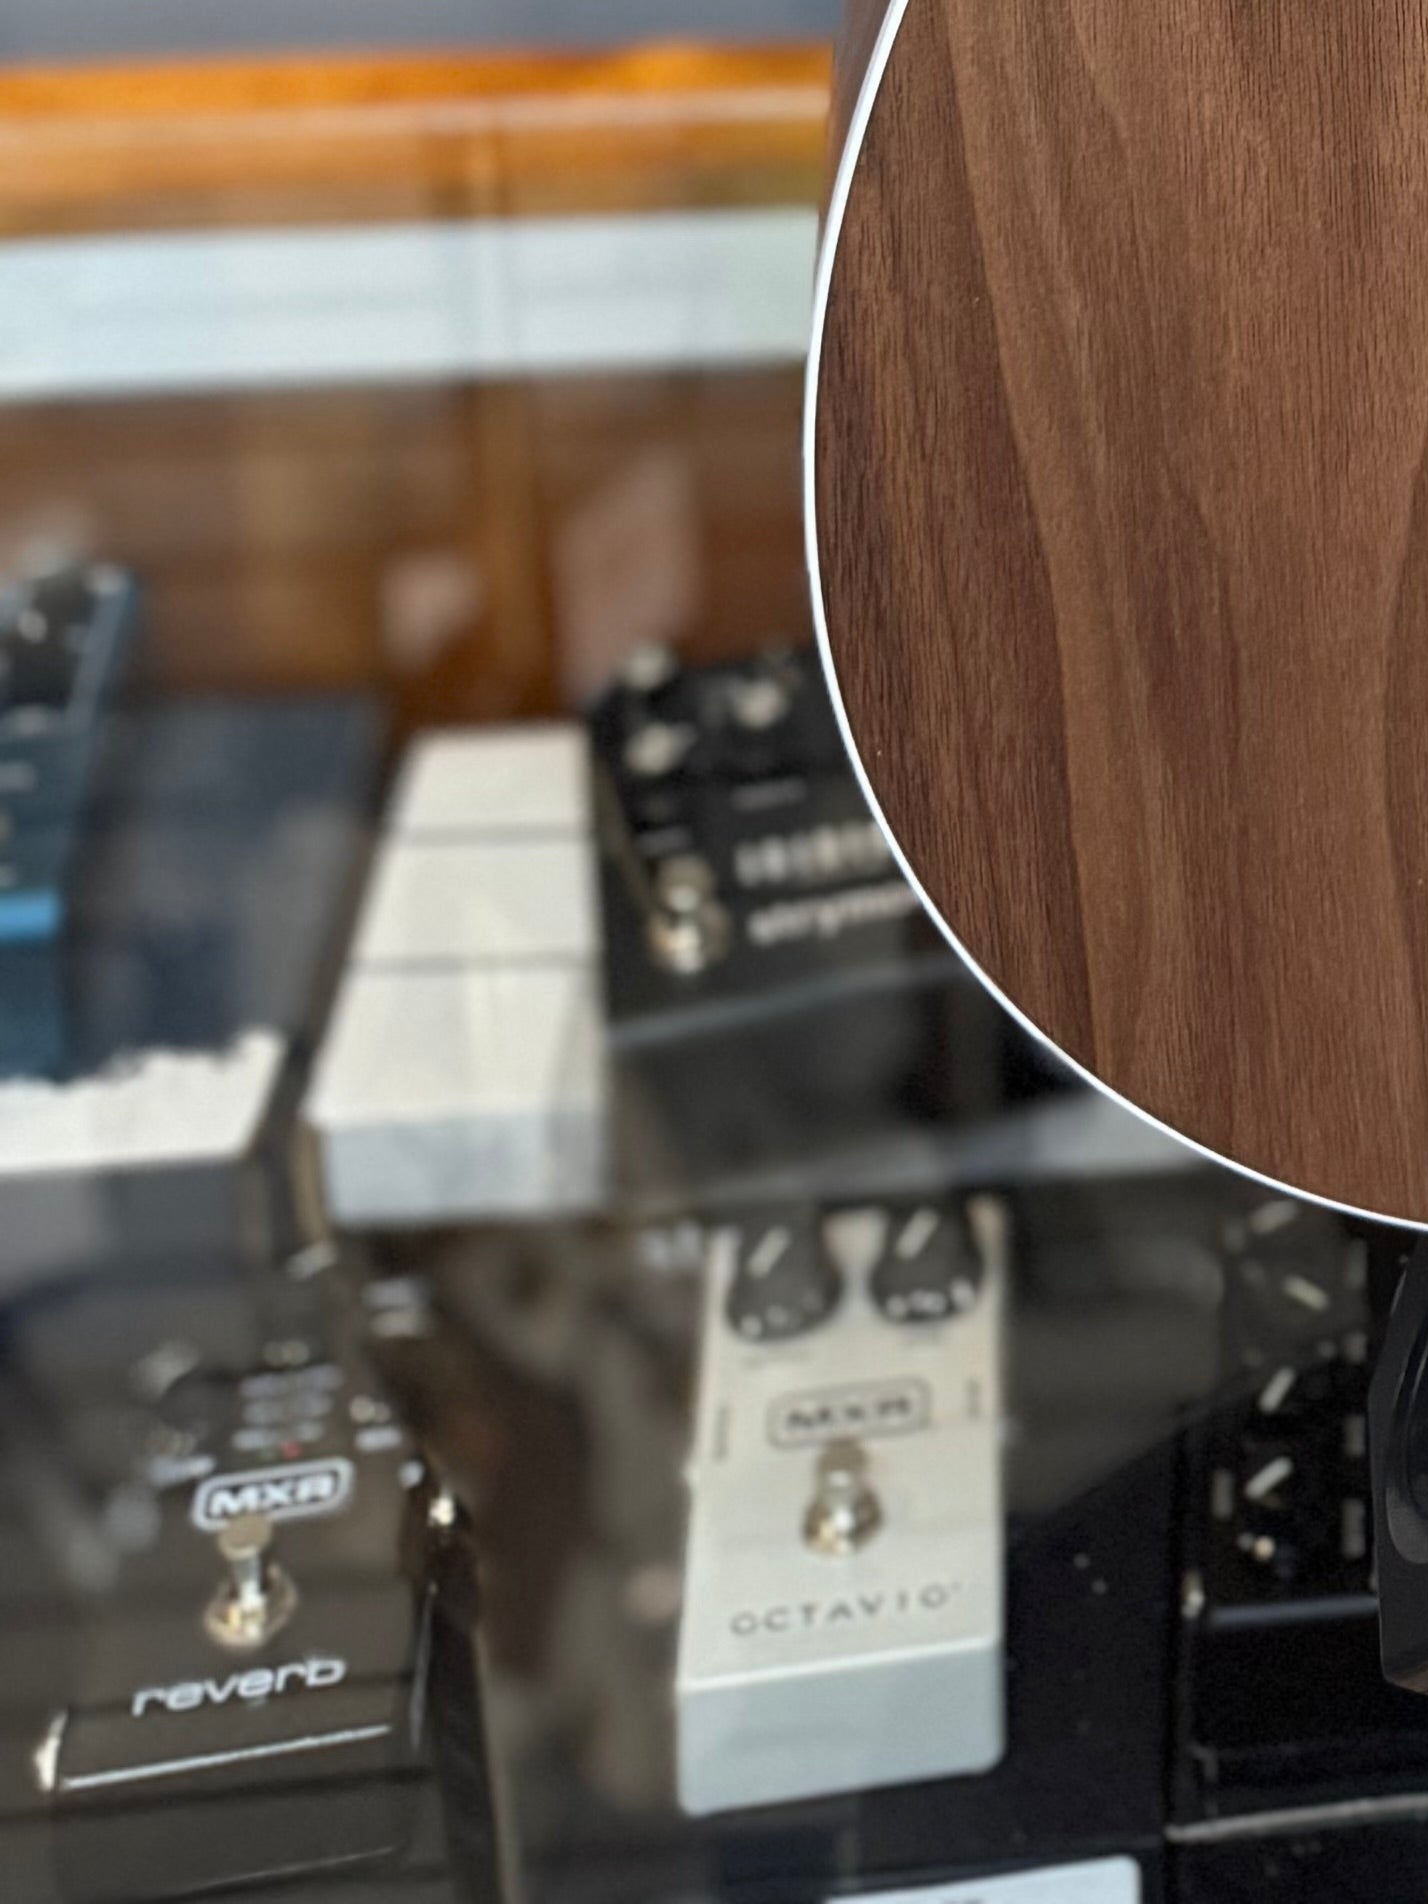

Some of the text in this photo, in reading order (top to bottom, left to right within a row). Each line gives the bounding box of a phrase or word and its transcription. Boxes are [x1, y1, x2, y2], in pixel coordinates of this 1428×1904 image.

[207, 1472, 335, 1517] MXR
[729, 1584, 950, 1636] OCTAVIO
[130, 1656, 347, 1717] reverb
